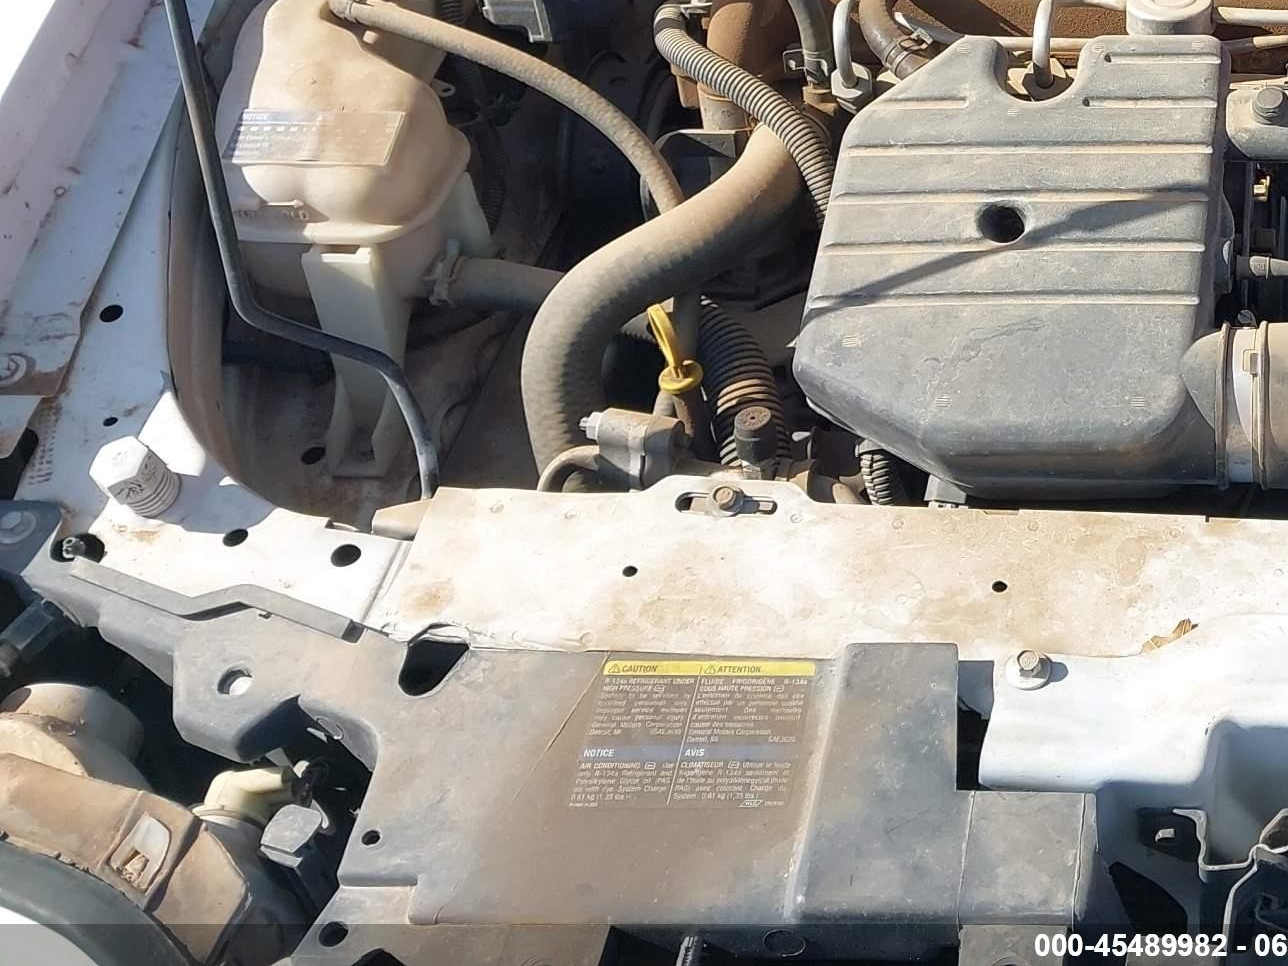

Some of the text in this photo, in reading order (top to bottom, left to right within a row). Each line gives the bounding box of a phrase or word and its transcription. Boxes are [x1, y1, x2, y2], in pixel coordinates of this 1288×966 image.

[622, 664, 658, 674] CAUTION
[717, 665, 762, 674] ATTENTION
[583, 748, 616, 758] NOTICE
[684, 748, 705, 757] AVIS
[593, 762, 641, 770] CONDITIONING
